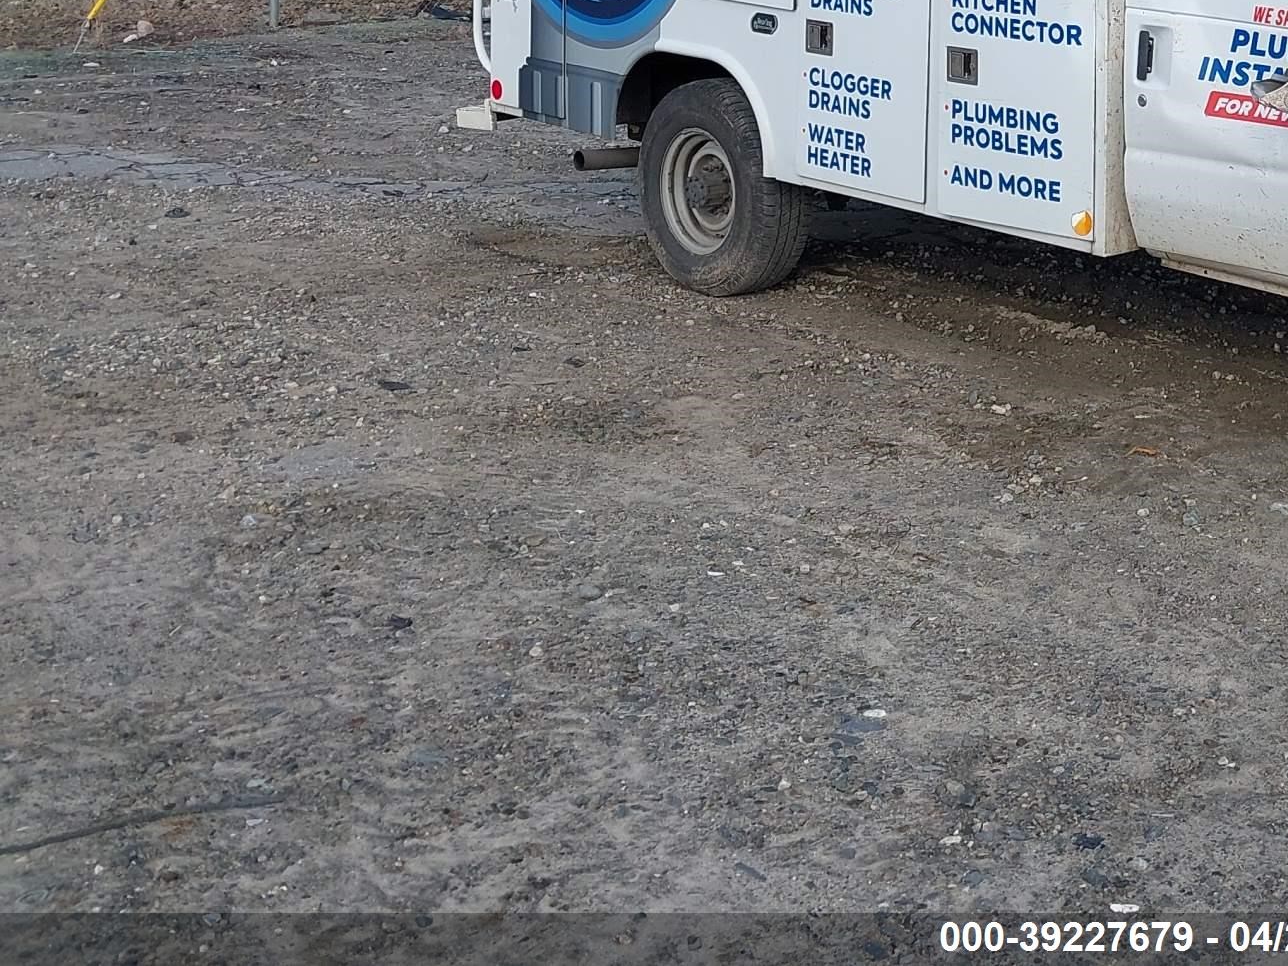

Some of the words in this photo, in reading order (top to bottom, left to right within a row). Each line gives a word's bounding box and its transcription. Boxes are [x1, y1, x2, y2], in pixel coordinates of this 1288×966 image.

[951, 12, 1083, 46] CONNECTOR
[1253, 6, 1272, 24] WE
[809, 67, 892, 100] CLOGGER
[808, 89, 871, 120] DRAINS
[952, 100, 1060, 135] PLUMBING
[1214, 97, 1254, 117] FOR
[808, 123, 866, 153] WATER
[951, 124, 1064, 160] PROBLEMS
[807, 146, 872, 178] HEATER
[950, 165, 993, 190] AND
[998, 174, 1061, 203] MORE
